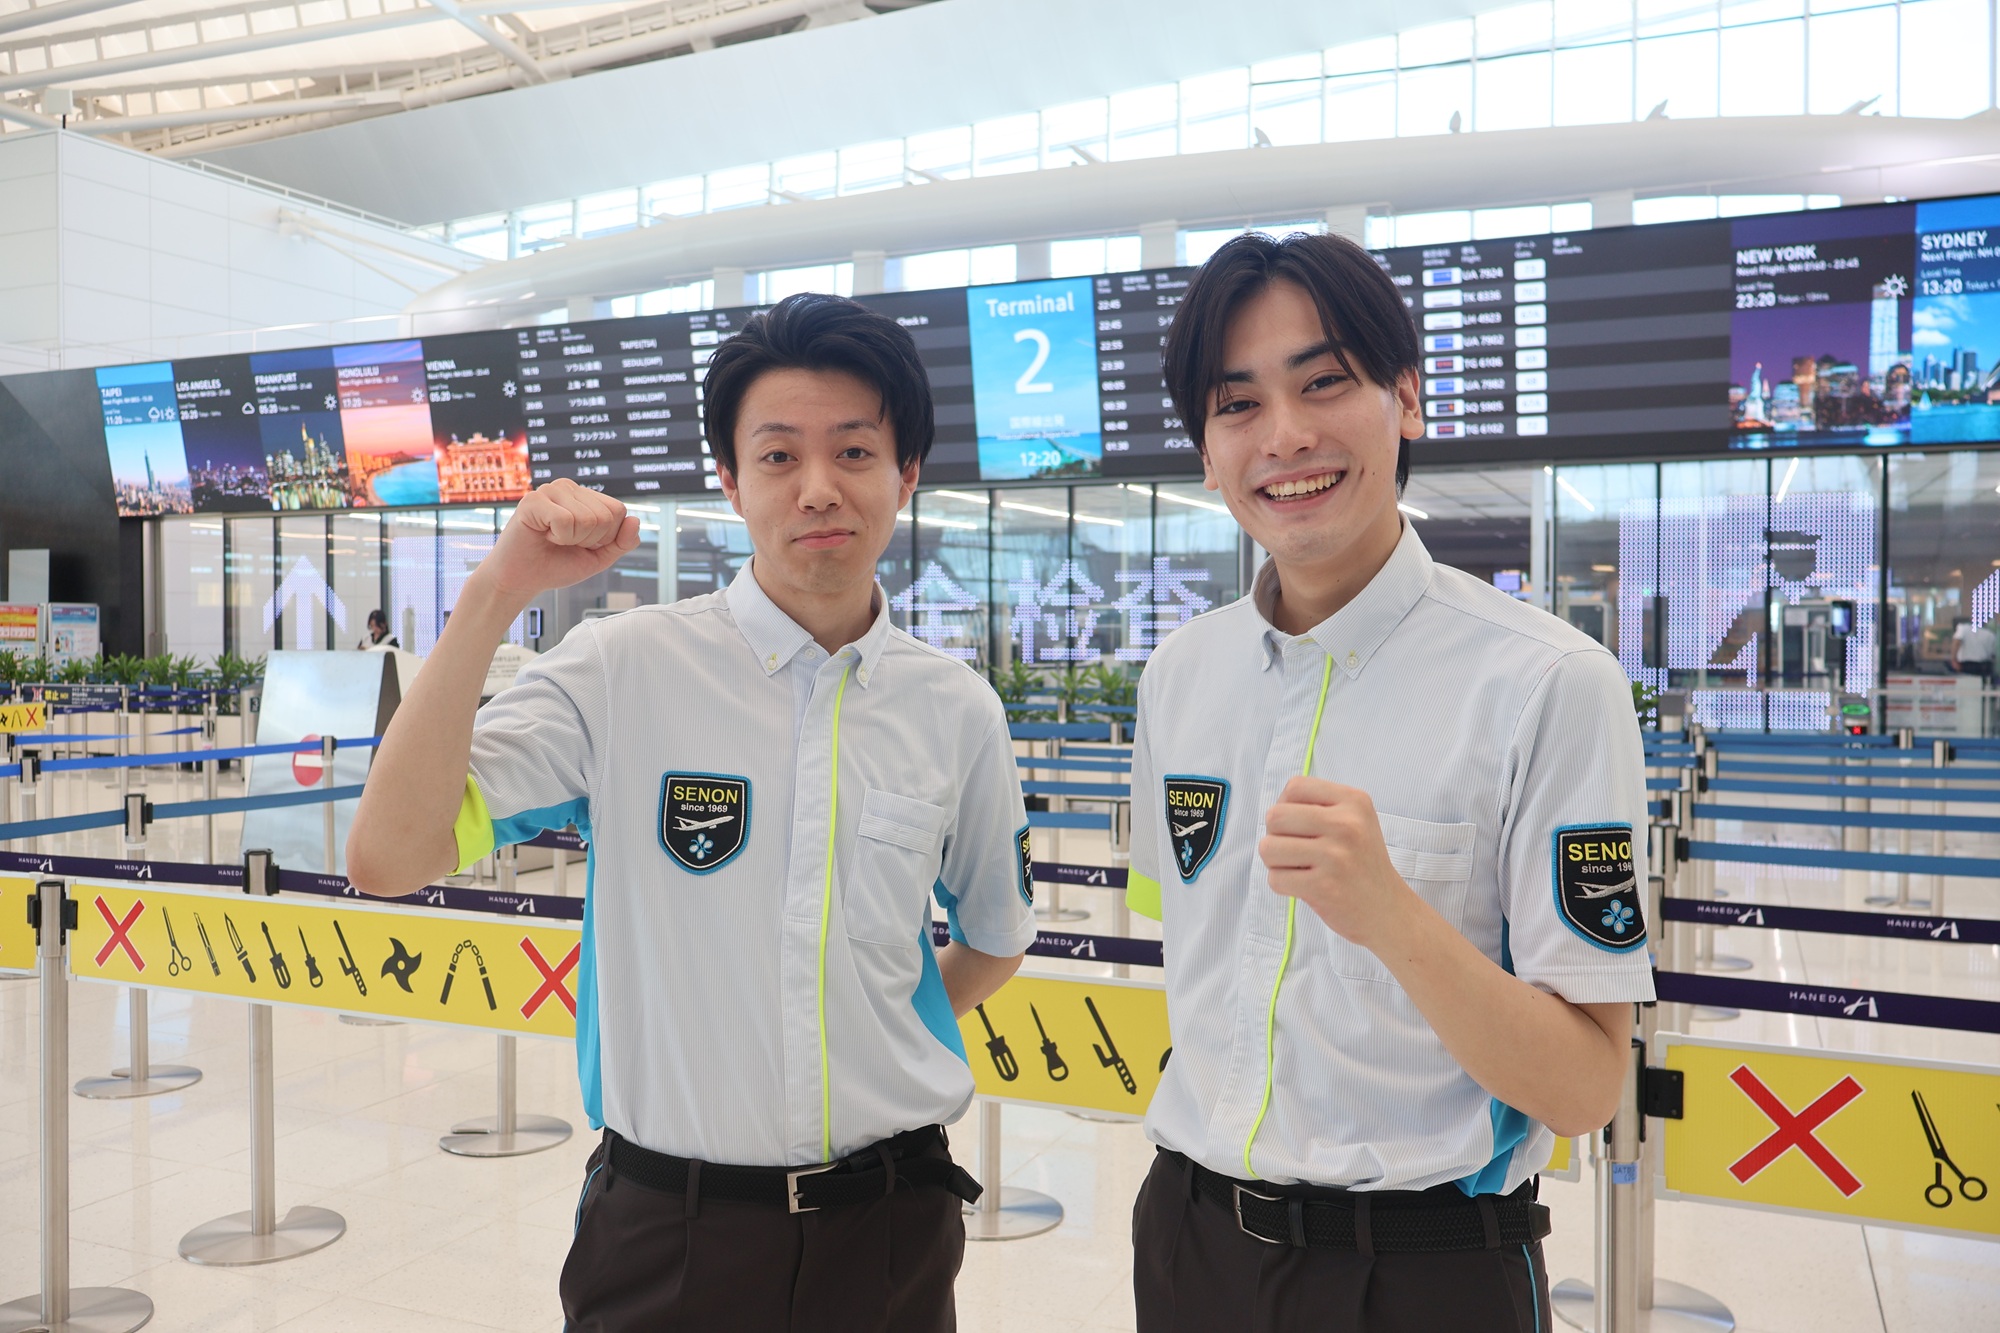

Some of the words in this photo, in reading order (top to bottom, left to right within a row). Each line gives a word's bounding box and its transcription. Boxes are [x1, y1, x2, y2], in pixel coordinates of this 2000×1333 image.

[1921, 230, 1987, 250] SYDNEY
[1736, 248, 1773, 264] NEW
[1774, 244, 1817, 261] YORK
[1462, 270, 1479, 281] UA
[1922, 278, 1962, 295] 13:20
[986, 291, 1075, 318] Terminal
[1097, 299, 1121, 310] 22:45
[1736, 291, 1776, 308] 23:20
[1098, 319, 1122, 331] 22:45
[1464, 336, 1479, 347] UA
[425, 359, 456, 371] VIENNA
[1013, 328, 1053, 394] 2
[338, 366, 379, 378] HONOLULU
[255, 372, 297, 385] FRANKFURT
[176, 381, 189, 392] LOS
[190, 378, 221, 390] ANGELES
[1464, 380, 1480, 391] UA
[101, 387, 122, 397] TAIPEI
[629, 427, 667, 438] FRANKFURT
[631, 445, 668, 455] HONOLULU
[1020, 450, 1062, 467] 12:20
[673, 786, 738, 804] SENON
[1168, 790, 1214, 808] SENON
[680, 803, 704, 812] since
[708, 804, 728, 813] 1969
[1174, 808, 1188, 817] since
[1190, 809, 1205, 818] 1969
[1568, 841, 1632, 861] SENO
[1057, 867, 1090, 876] HANEDA
[1581, 863, 1613, 874] since
[318, 879, 345, 887] HANEDA
[488, 896, 519, 904] HANEDA
[1697, 905, 1741, 915] HANEDA
[1886, 918, 1934, 929] HANEDA
[1789, 991, 1846, 1004] HANEDA
